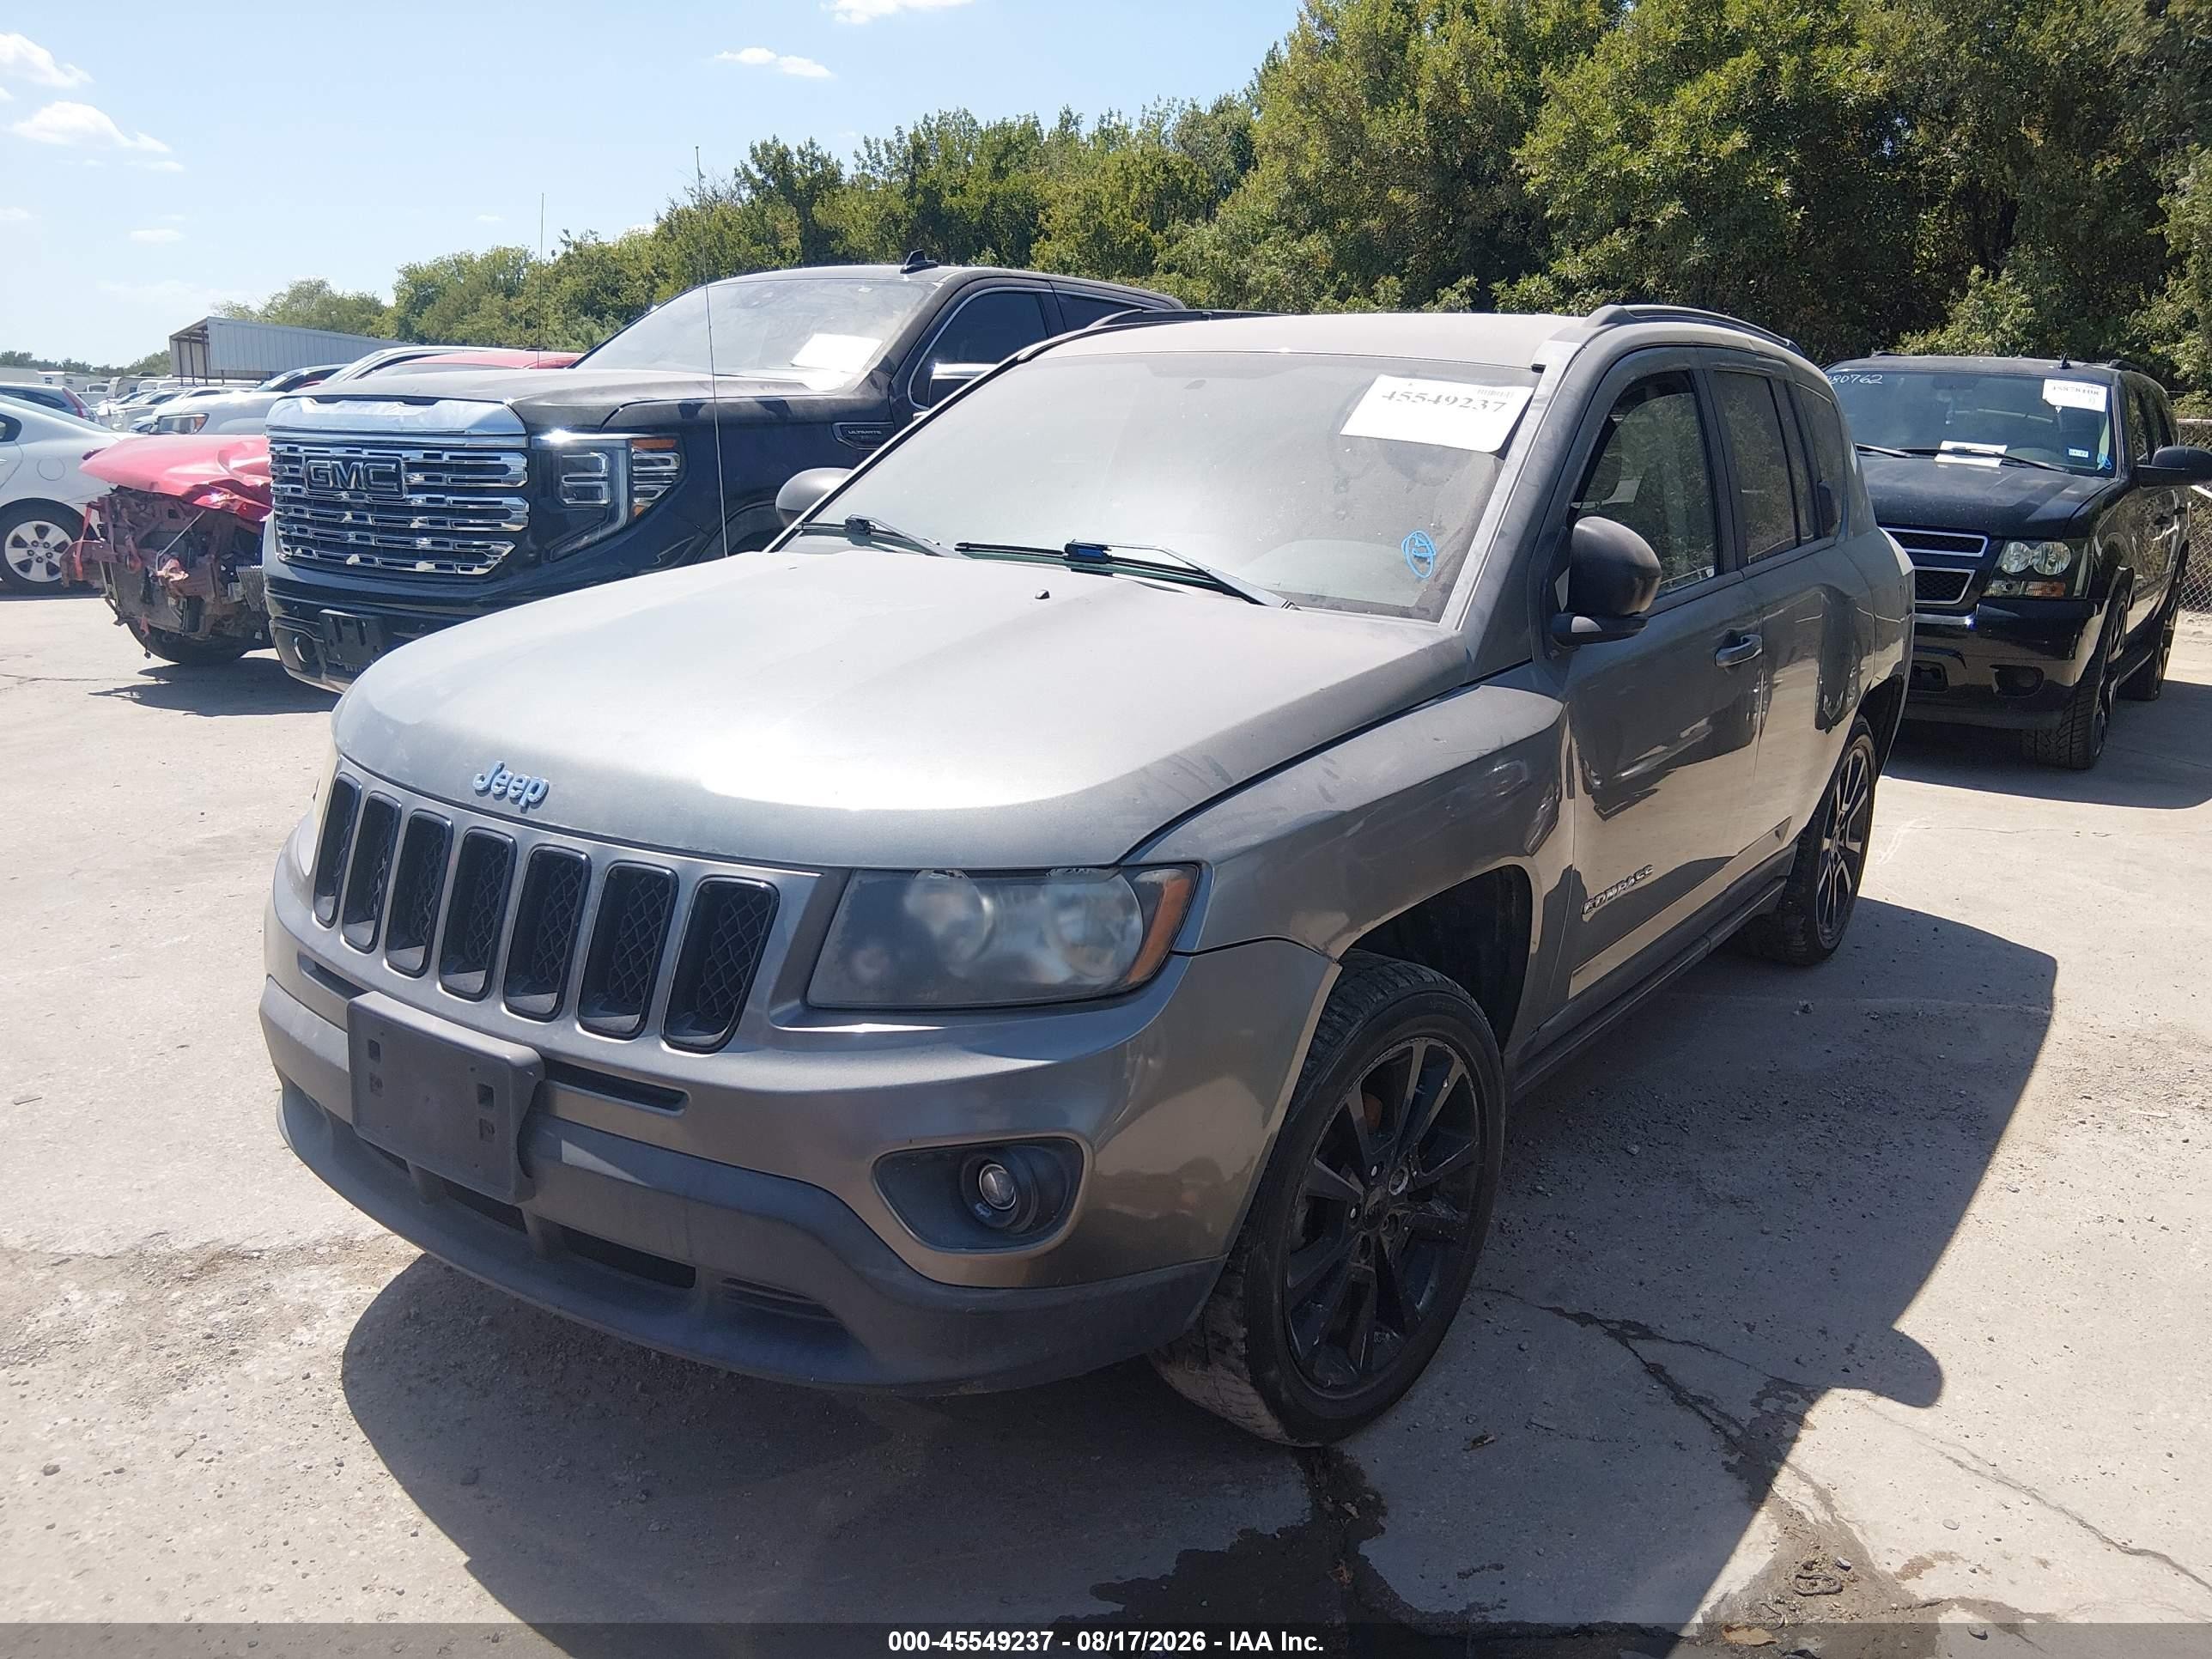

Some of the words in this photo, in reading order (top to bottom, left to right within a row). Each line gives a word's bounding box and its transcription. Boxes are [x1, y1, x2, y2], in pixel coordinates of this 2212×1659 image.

[1382, 391, 1508, 412] 45549237
[307, 459, 399, 492] GMC
[473, 761, 550, 807] Jeep
